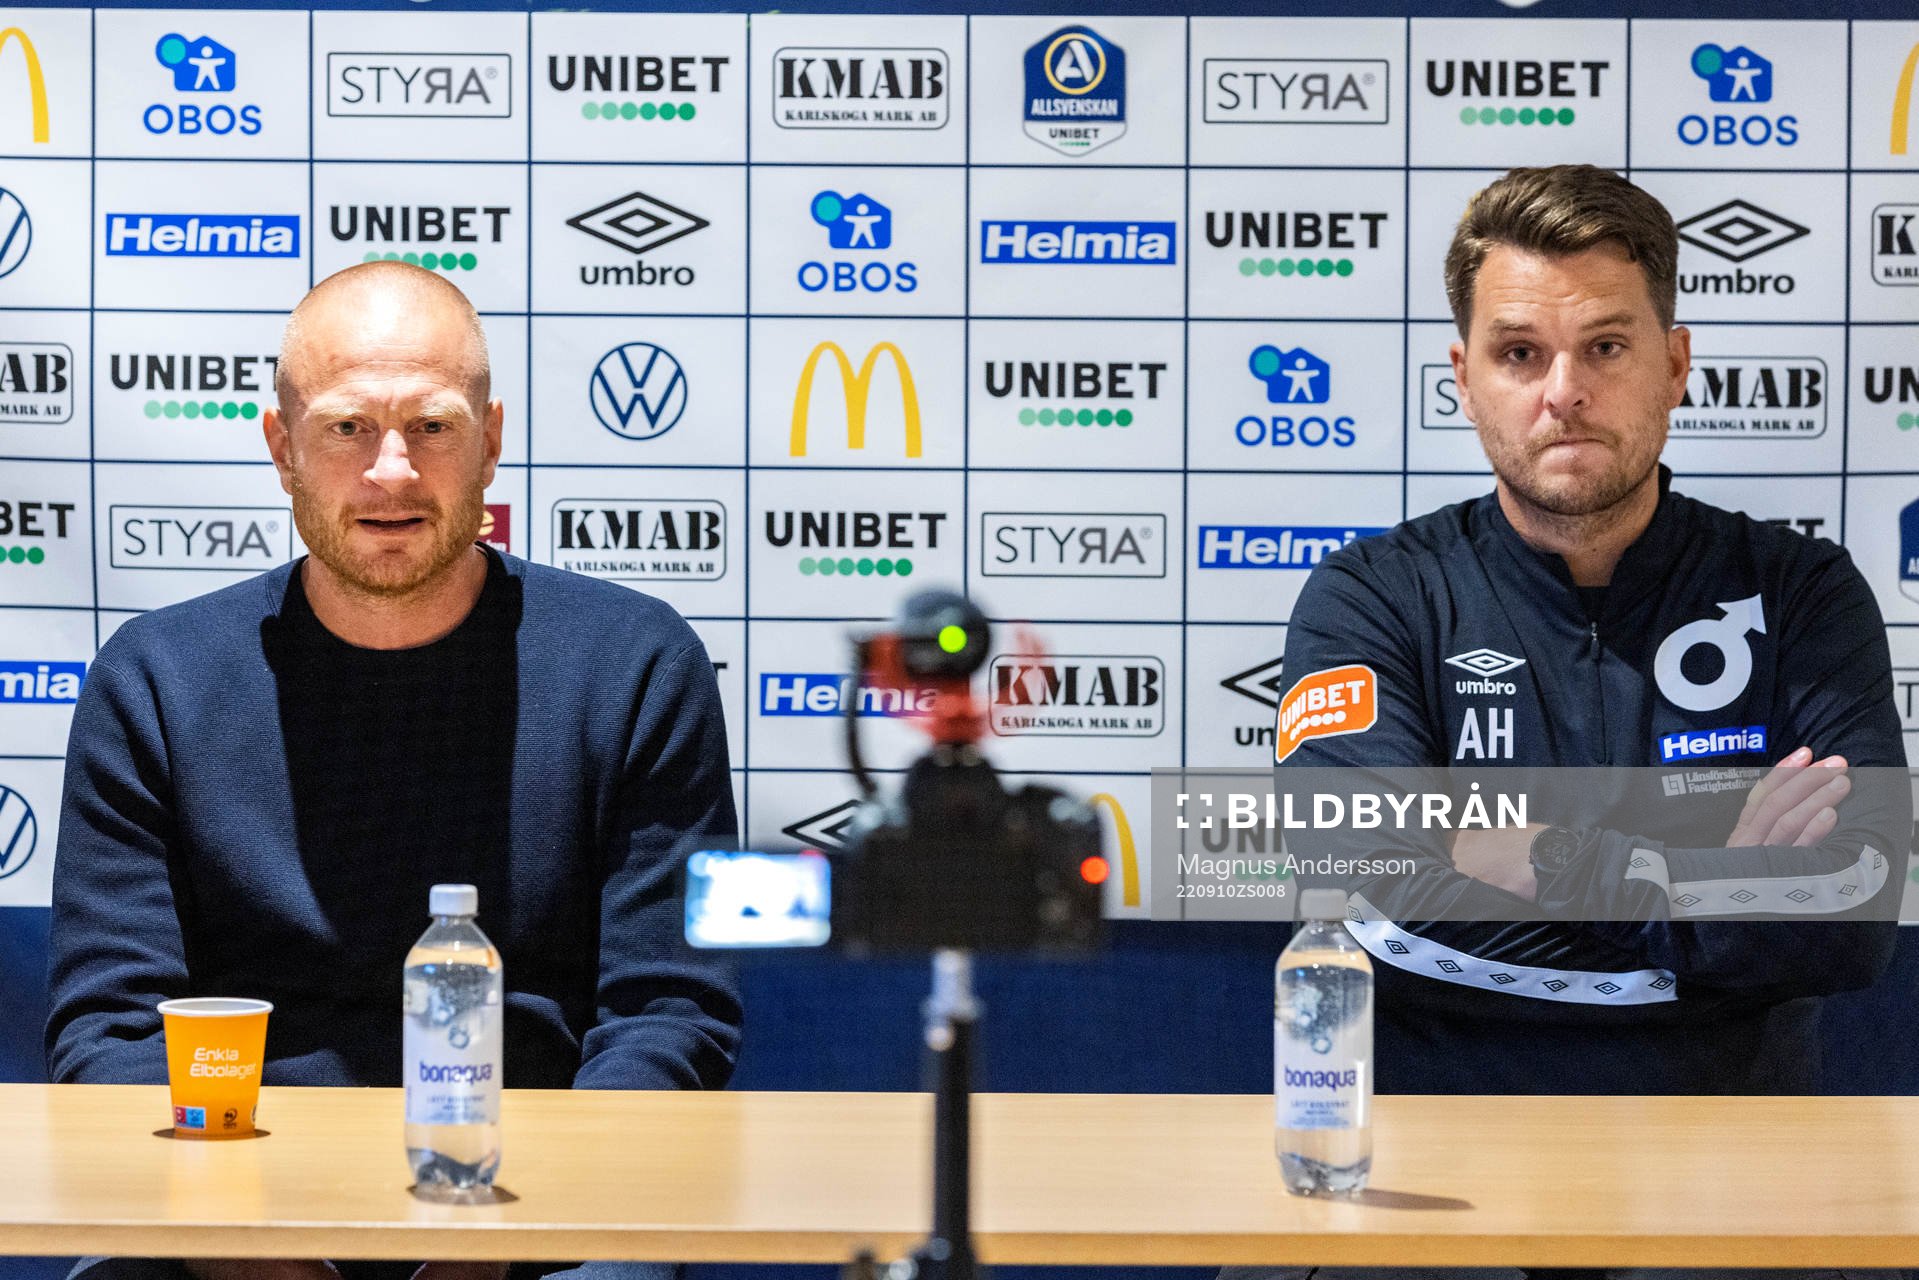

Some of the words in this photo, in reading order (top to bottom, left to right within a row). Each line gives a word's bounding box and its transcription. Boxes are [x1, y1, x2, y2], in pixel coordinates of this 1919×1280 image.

[548, 55, 730, 93] UNIBET
[779, 58, 943, 100] KMAB
[1426, 60, 1610, 98] UNIBET
[142, 103, 262, 136] OBOS
[785, 110, 868, 122] KARLSKOGA
[873, 111, 914, 122] MARK
[919, 111, 937, 122] AB
[1030, 98, 1118, 116] ALLSVENSKAN
[1049, 128, 1100, 139] UNIBET
[1676, 114, 1799, 147] OBOS
[109, 217, 293, 253] Helmia
[330, 205, 511, 243] UNIBET
[1205, 211, 1389, 249] UNIBET
[985, 224, 1169, 260] Helmia
[580, 259, 695, 287] umbro
[797, 260, 918, 294] OBOS
[1679, 267, 1796, 295] umbro
[0, 353, 68, 394] AB
[985, 361, 1168, 399] UNIBET
[0, 404, 39, 416] MARK
[44, 405, 62, 416] AB
[1670, 419, 1746, 431] ARLSKOGA
[1751, 419, 1791, 431] MARK
[1797, 420, 1815, 431] AB
[1234, 415, 1357, 448] OBOS
[0, 500, 76, 538] BET
[557, 509, 721, 551] KMAB
[765, 511, 947, 549] UNIBET
[564, 561, 646, 573] KARLSKOGA
[651, 562, 691, 573] MARK
[696, 562, 715, 573] AB
[0, 664, 80, 700] mia
[994, 664, 1159, 708] KMAB
[1455, 678, 1517, 695] umbro
[1001, 716, 1084, 729] KARLSKOGA
[1088, 717, 1129, 730] MARK
[1134, 718, 1153, 730] AB
[1281, 679, 1366, 733] UNIBET
[1455, 707, 1514, 760] AH
[1662, 729, 1764, 759] Helmia
[1201, 817, 1283, 854] UNI
[419, 1061, 493, 1086] bonaqua
[1284, 1066, 1357, 1092] bonaqua
